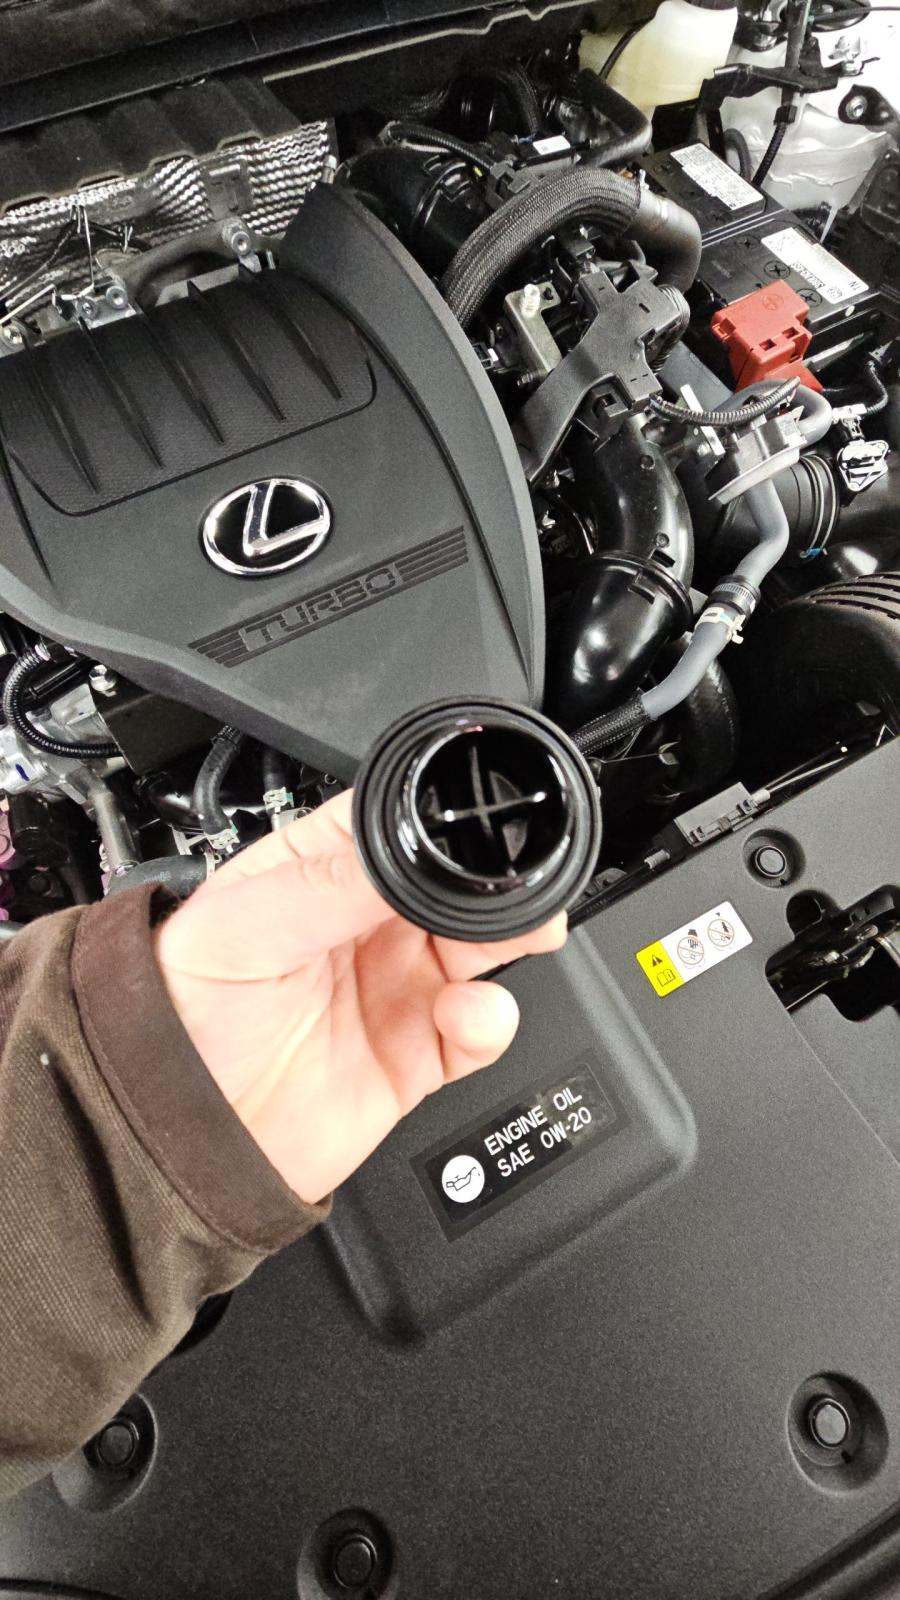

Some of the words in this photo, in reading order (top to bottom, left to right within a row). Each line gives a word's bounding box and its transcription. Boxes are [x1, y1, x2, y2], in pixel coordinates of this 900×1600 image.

[241, 565, 398, 644] TURBO
[484, 1105, 548, 1156] ENGINE
[552, 1087, 583, 1111] OIL
[497, 1142, 536, 1177] SAE
[540, 1106, 592, 1149] 0W-20
